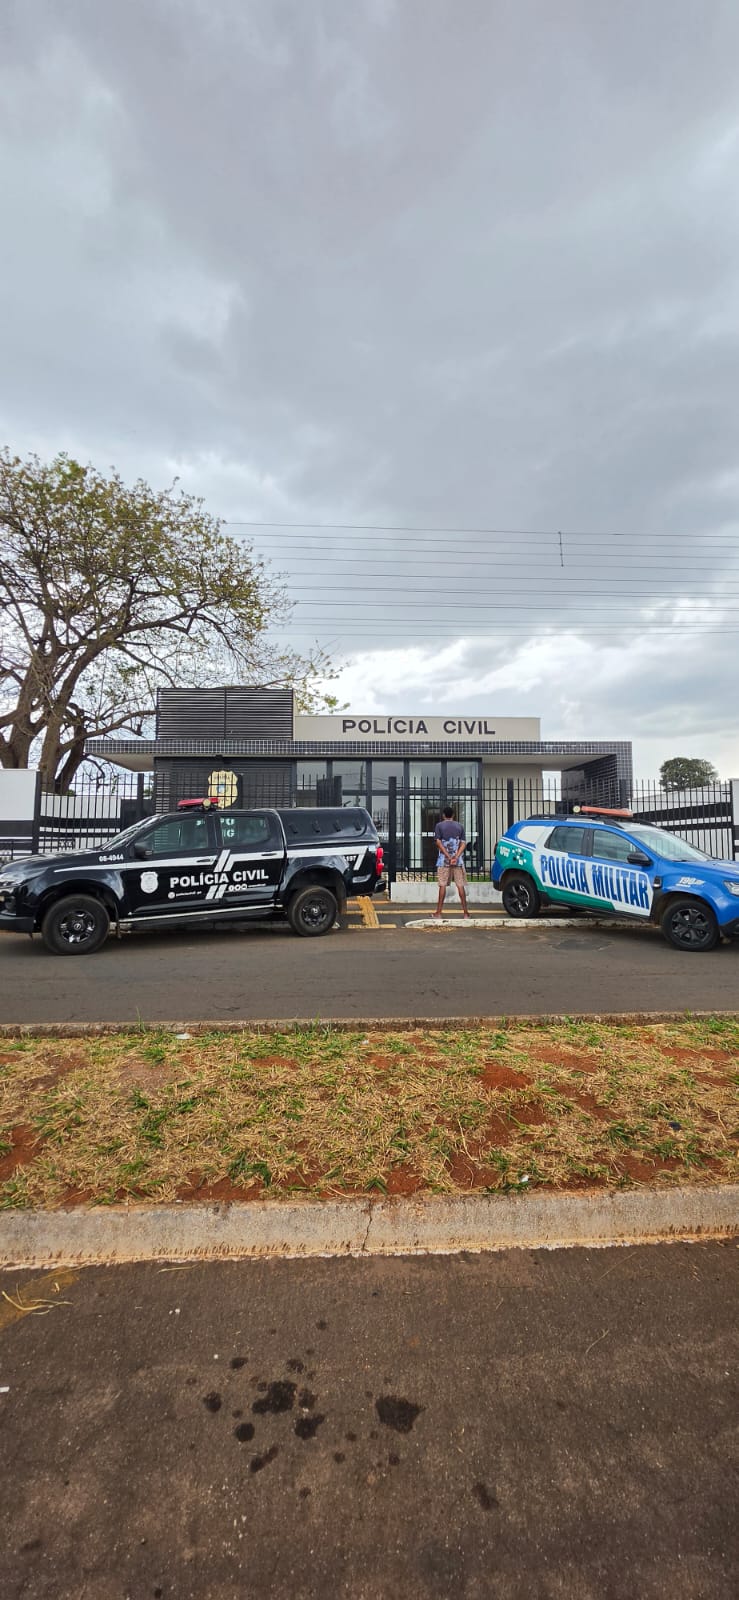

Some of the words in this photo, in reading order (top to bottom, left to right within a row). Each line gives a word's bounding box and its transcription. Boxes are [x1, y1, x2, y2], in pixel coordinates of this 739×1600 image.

[342, 717, 429, 734] POLÍCIA
[443, 720, 496, 735] CIVIL
[169, 872, 229, 889] POLÍCIA
[232, 869, 270, 882] CIVIL
[591, 864, 650, 910] MILITAR
